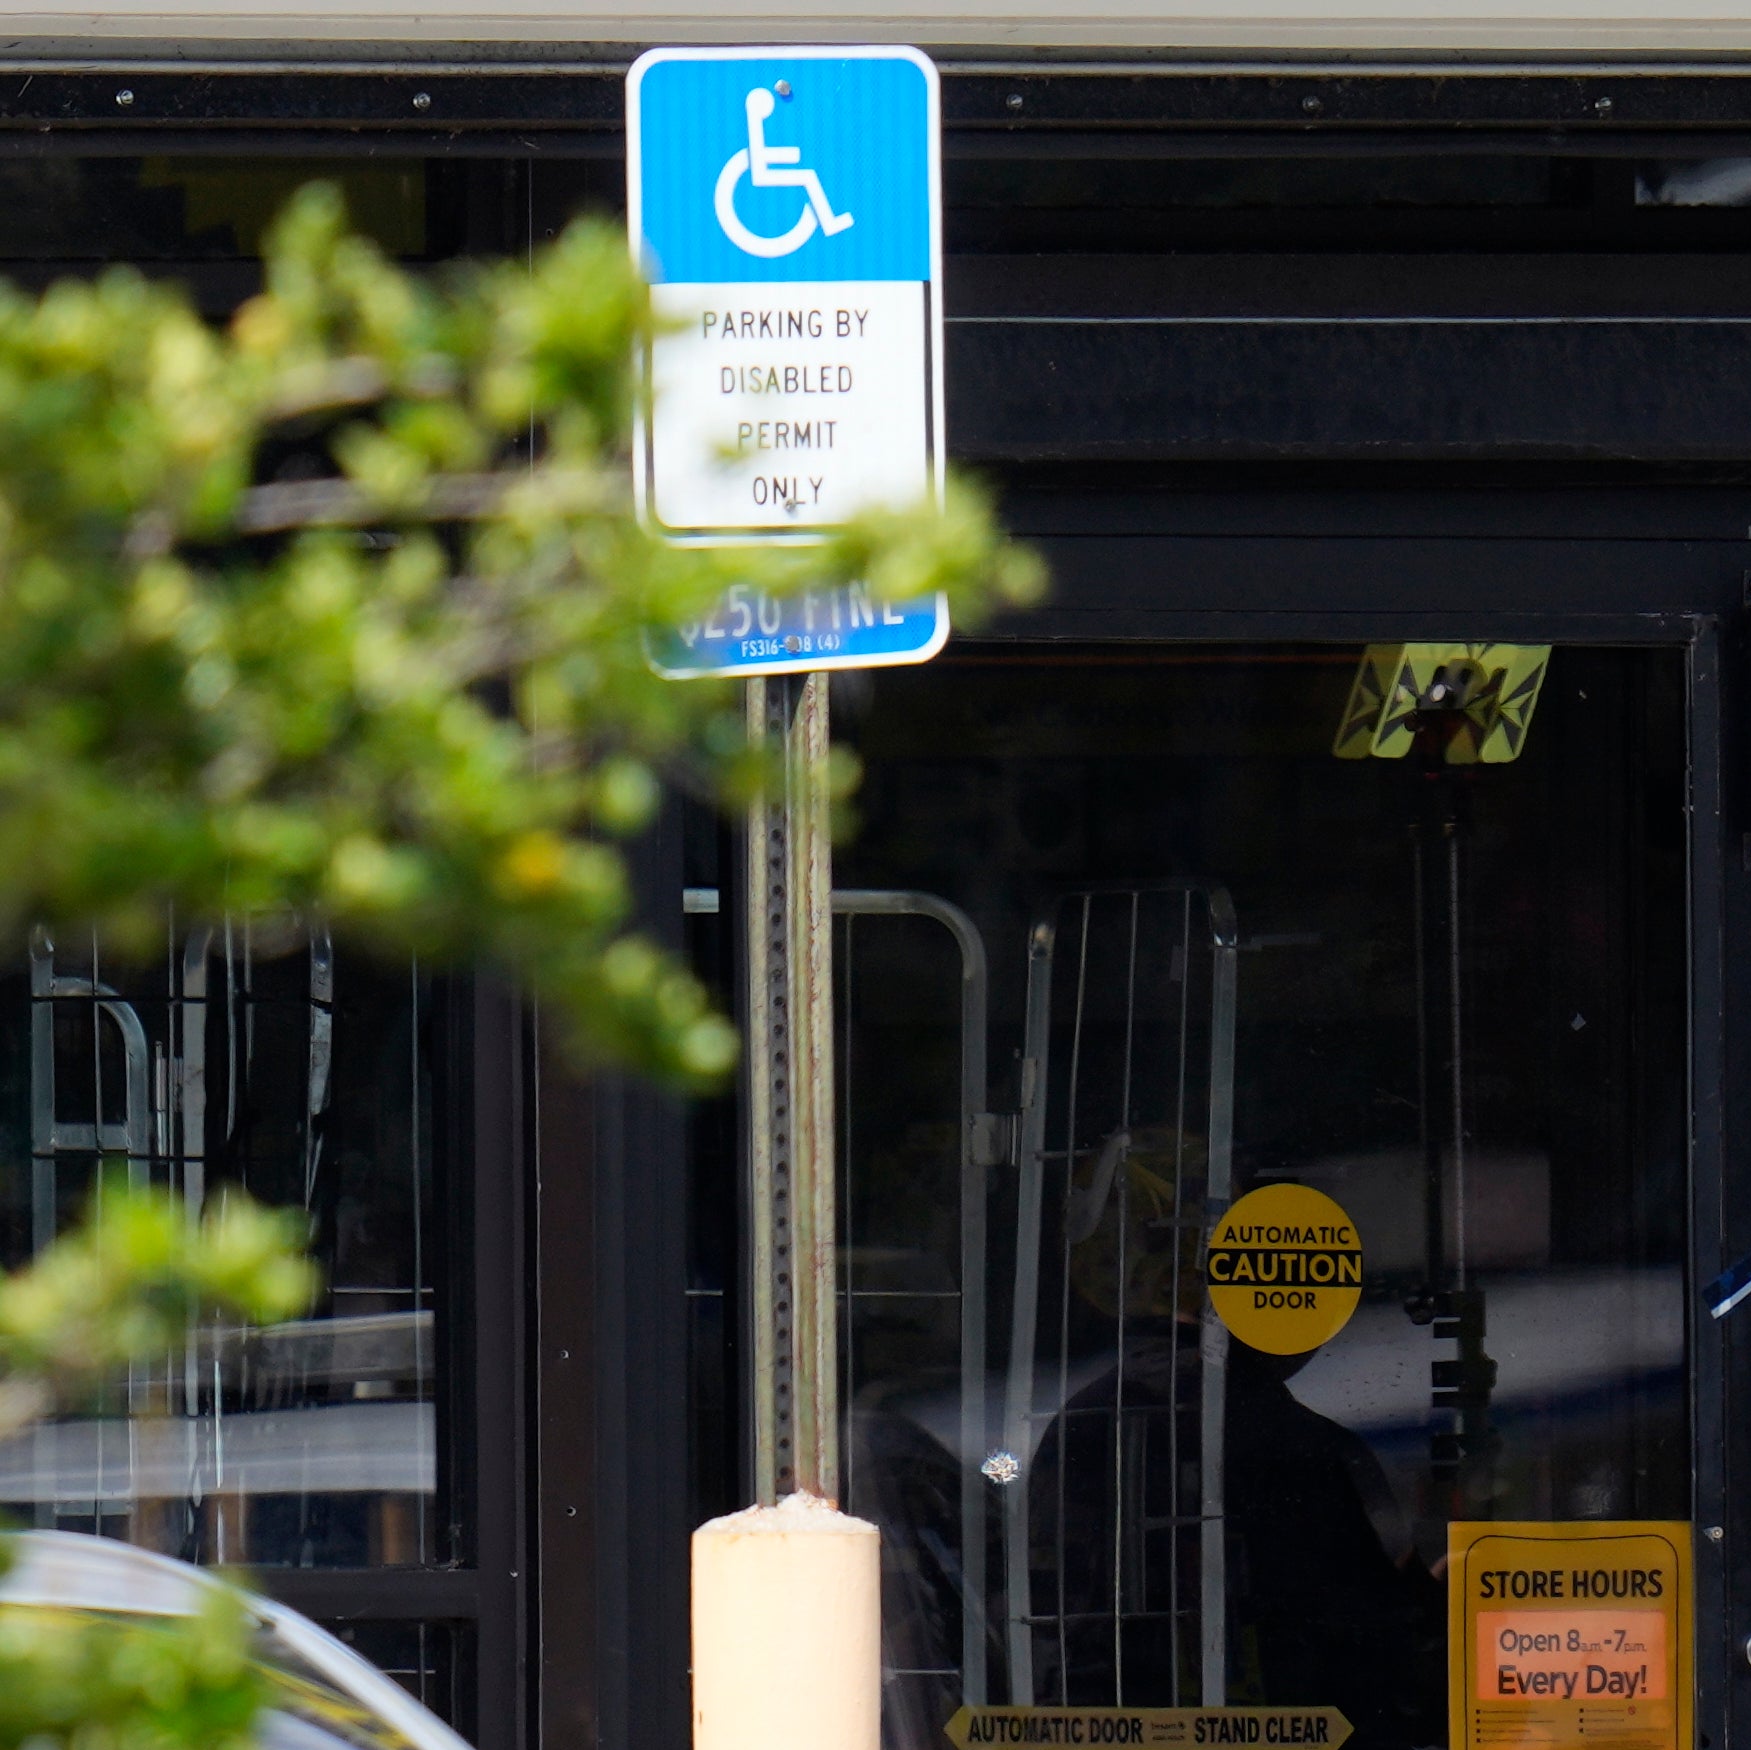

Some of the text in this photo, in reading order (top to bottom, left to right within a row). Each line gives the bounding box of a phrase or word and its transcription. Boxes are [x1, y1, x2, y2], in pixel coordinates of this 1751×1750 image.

[703, 309, 868, 339] PARKING BY
[721, 366, 853, 394] DISABLED
[738, 421, 837, 449] PERMIT
[753, 476, 823, 505] ONLY
[818, 635, 840, 650] (4)
[1223, 1226, 1350, 1244] AUTOMATIC
[1209, 1252, 1361, 1283] CAUTION
[1254, 1291, 1316, 1310] DOOR
[1479, 1569, 1663, 1599] STORE HOURS
[1500, 1629, 1560, 1656] Open
[1498, 1665, 1647, 1699] Every Day!
[967, 1715, 1329, 1745] AUTOMATIC DOOR STAND CLEAR
